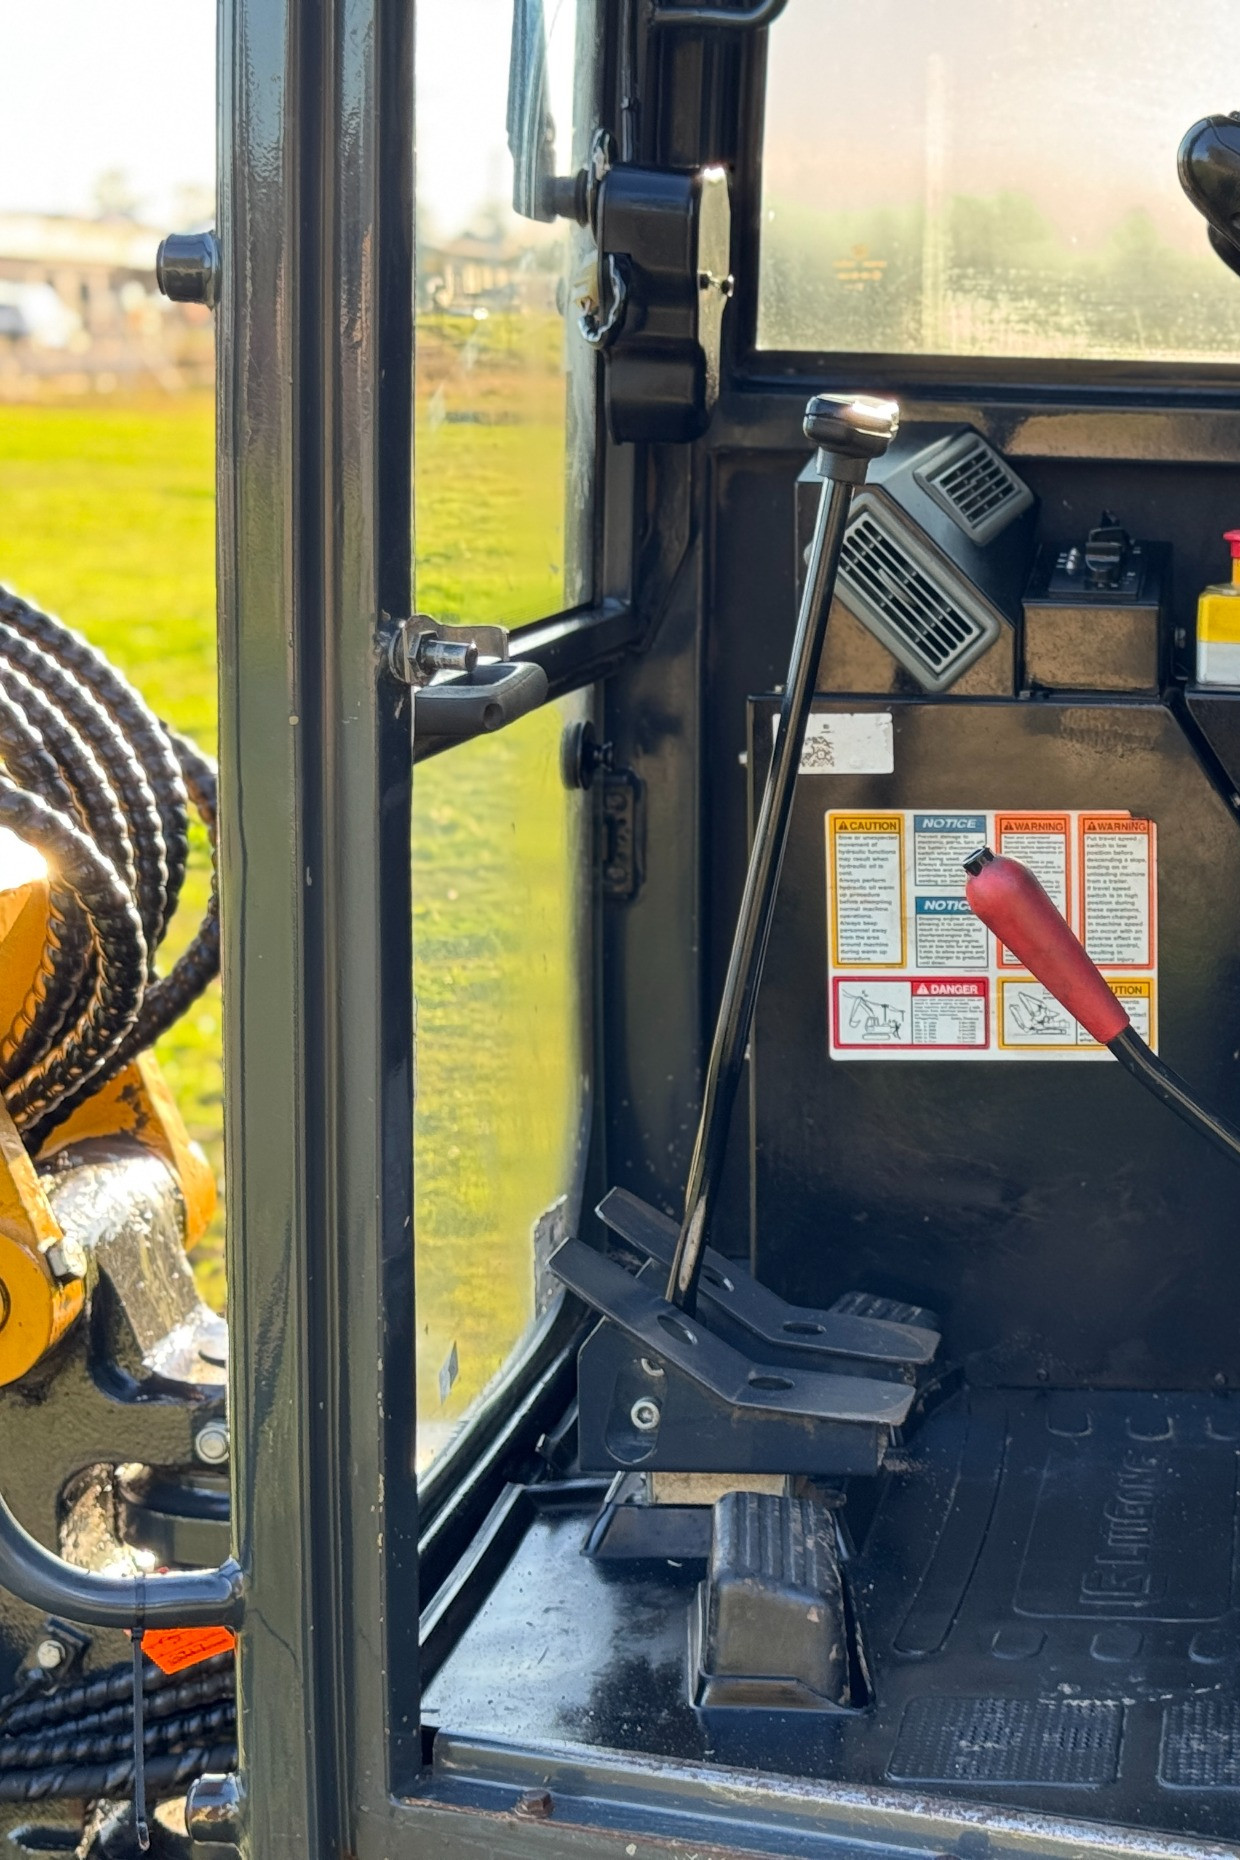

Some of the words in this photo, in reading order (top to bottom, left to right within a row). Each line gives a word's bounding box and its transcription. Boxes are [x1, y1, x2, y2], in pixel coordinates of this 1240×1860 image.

[850, 821, 897, 830] CAUTION
[922, 818, 976, 828] NOTICE
[1014, 822, 1064, 830] WARNING
[1097, 822, 1146, 831] WARNING
[924, 900, 971, 910] NOTIC
[930, 984, 979, 994] DANGER
[1111, 986, 1142, 994] UTION
